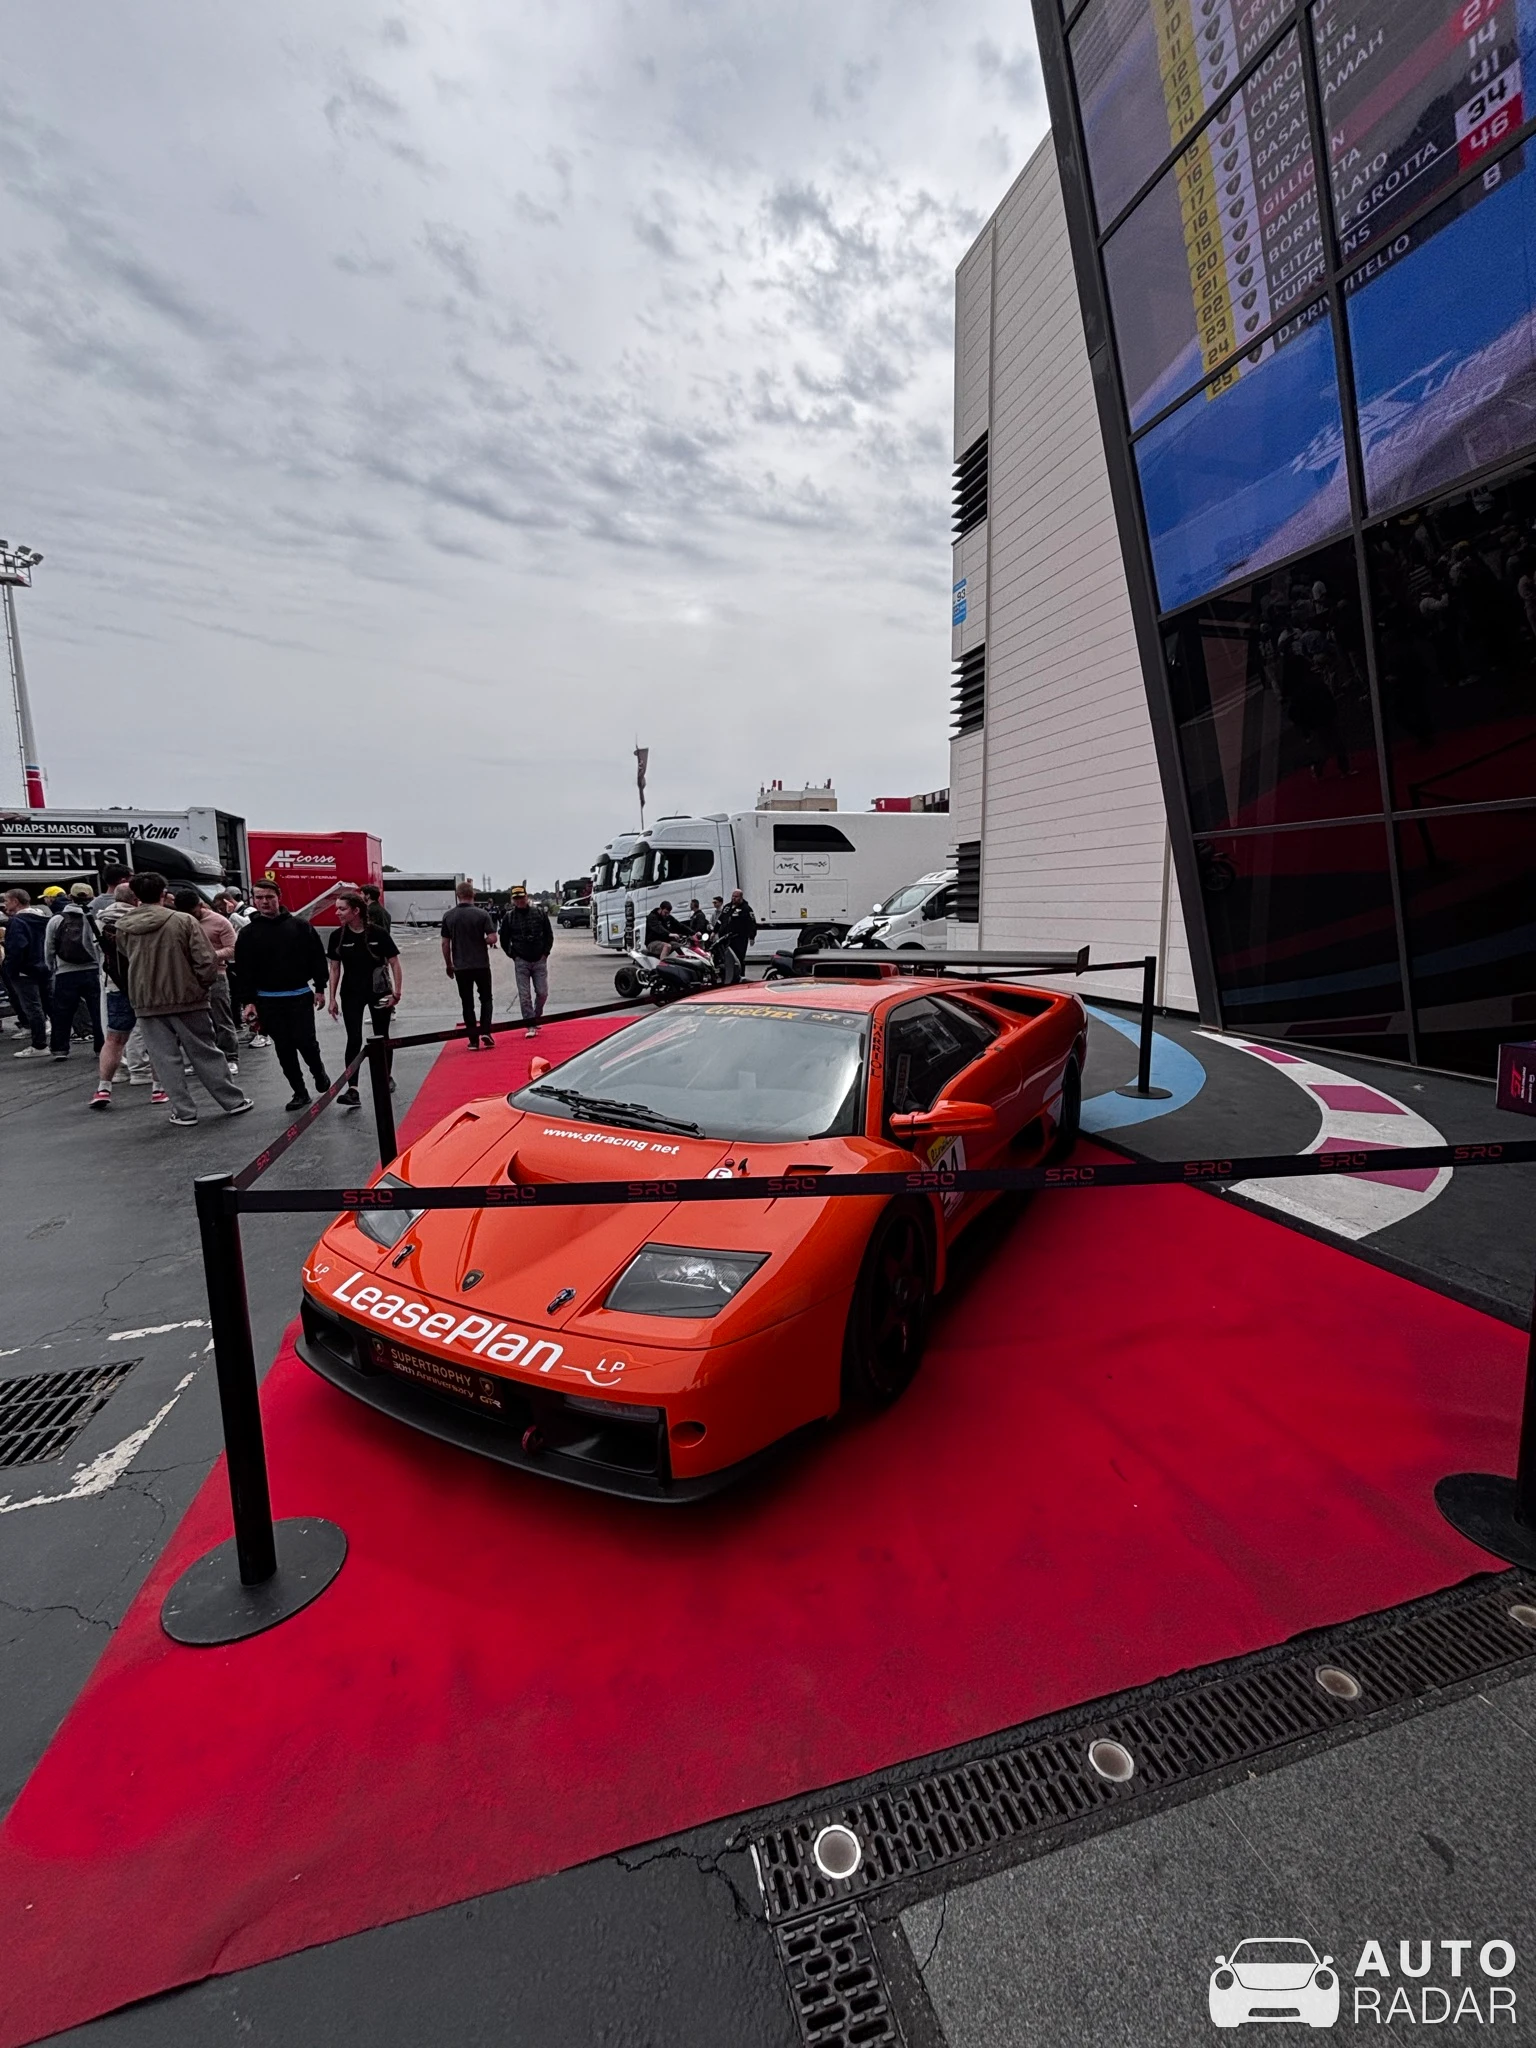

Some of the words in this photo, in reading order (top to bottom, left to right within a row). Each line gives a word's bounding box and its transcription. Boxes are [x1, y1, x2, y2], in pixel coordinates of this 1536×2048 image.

[1165, 12, 1181, 40] 10
[1468, 17, 1498, 59] 14
[1170, 40, 1181, 61] 11
[1171, 59, 1188, 87] 12
[1470, 49, 1499, 85] 41
[1175, 83, 1191, 112] 13
[1467, 78, 1508, 126] 34
[1178, 107, 1195, 134] 14
[1470, 110, 1510, 150] 46
[1182, 140, 1199, 167] 15
[1186, 163, 1203, 189] 16
[1356, 141, 1439, 215] GROTTA
[1190, 185, 1204, 211] 17
[1192, 209, 1208, 234] 18
[1195, 231, 1212, 256] 19
[1196, 251, 1218, 281] 20
[1202, 274, 1217, 299] 21
[1202, 294, 1223, 323] 22
[1205, 316, 1227, 343] 23
[1208, 338, 1229, 366] 24
[1211, 371, 1233, 395] 25
[2, 824, 46, 834] WRAPS
[47, 824, 95, 834] MAISON
[6, 848, 120, 866] EVENTS
[265, 850, 301, 868] AF
[296, 855, 336, 863] corse
[773, 883, 804, 894] DTM
[1319, 1153, 1367, 1167] SRO
[1454, 1145, 1502, 1159] SRO
[906, 1173, 955, 1186] SRO
[1045, 1168, 1094, 1181] SRO
[1184, 1161, 1232, 1175] SRO
[343, 1191, 392, 1204] SRO
[486, 1187, 536, 1200] SRO
[628, 1182, 677, 1196] SRO
[767, 1178, 816, 1191] SRO
[332, 1271, 564, 1372] LeasePlan
[391, 1348, 471, 1386] SUPERTROPHY
[392, 1361, 415, 1376] 30th
[417, 1370, 474, 1398] Anniversary
